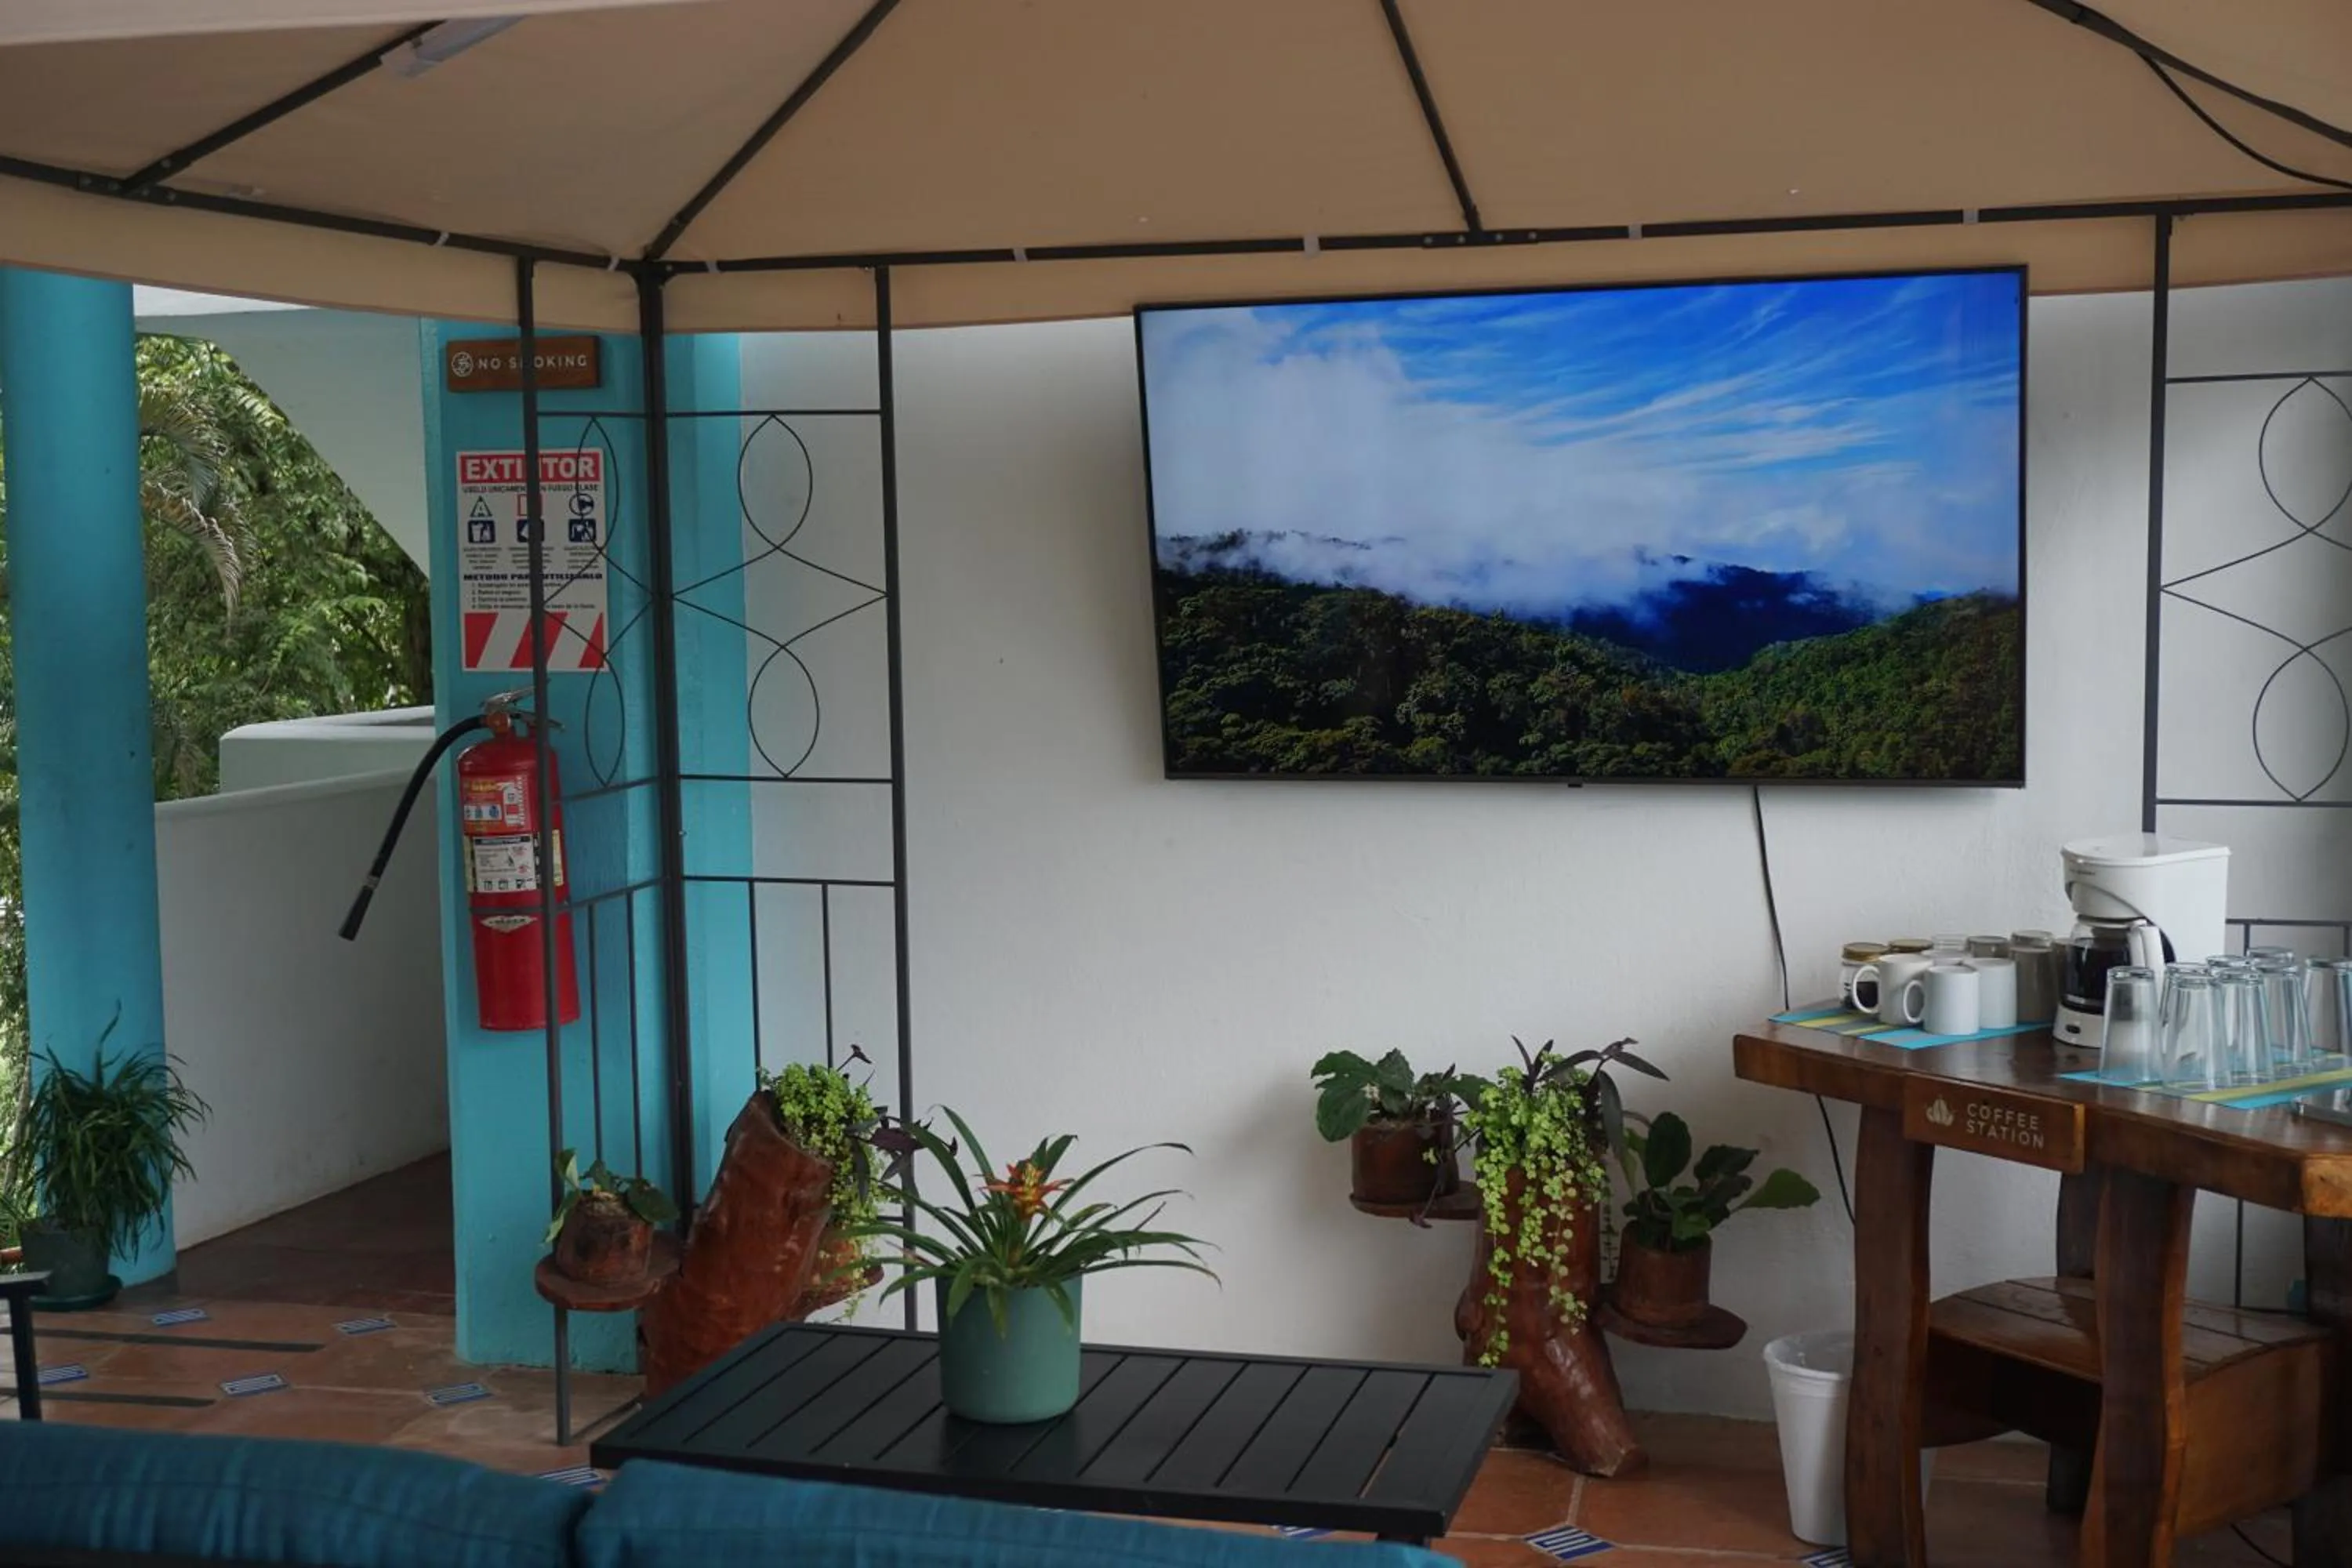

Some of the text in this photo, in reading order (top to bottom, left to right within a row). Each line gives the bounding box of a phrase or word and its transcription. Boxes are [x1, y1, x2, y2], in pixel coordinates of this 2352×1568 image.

[478, 354, 587, 370] NO SOKING
[466, 456, 595, 480] EXTITOR
[1967, 1103, 2040, 1131] COFFEE
[1966, 1120, 2045, 1149] STATION
